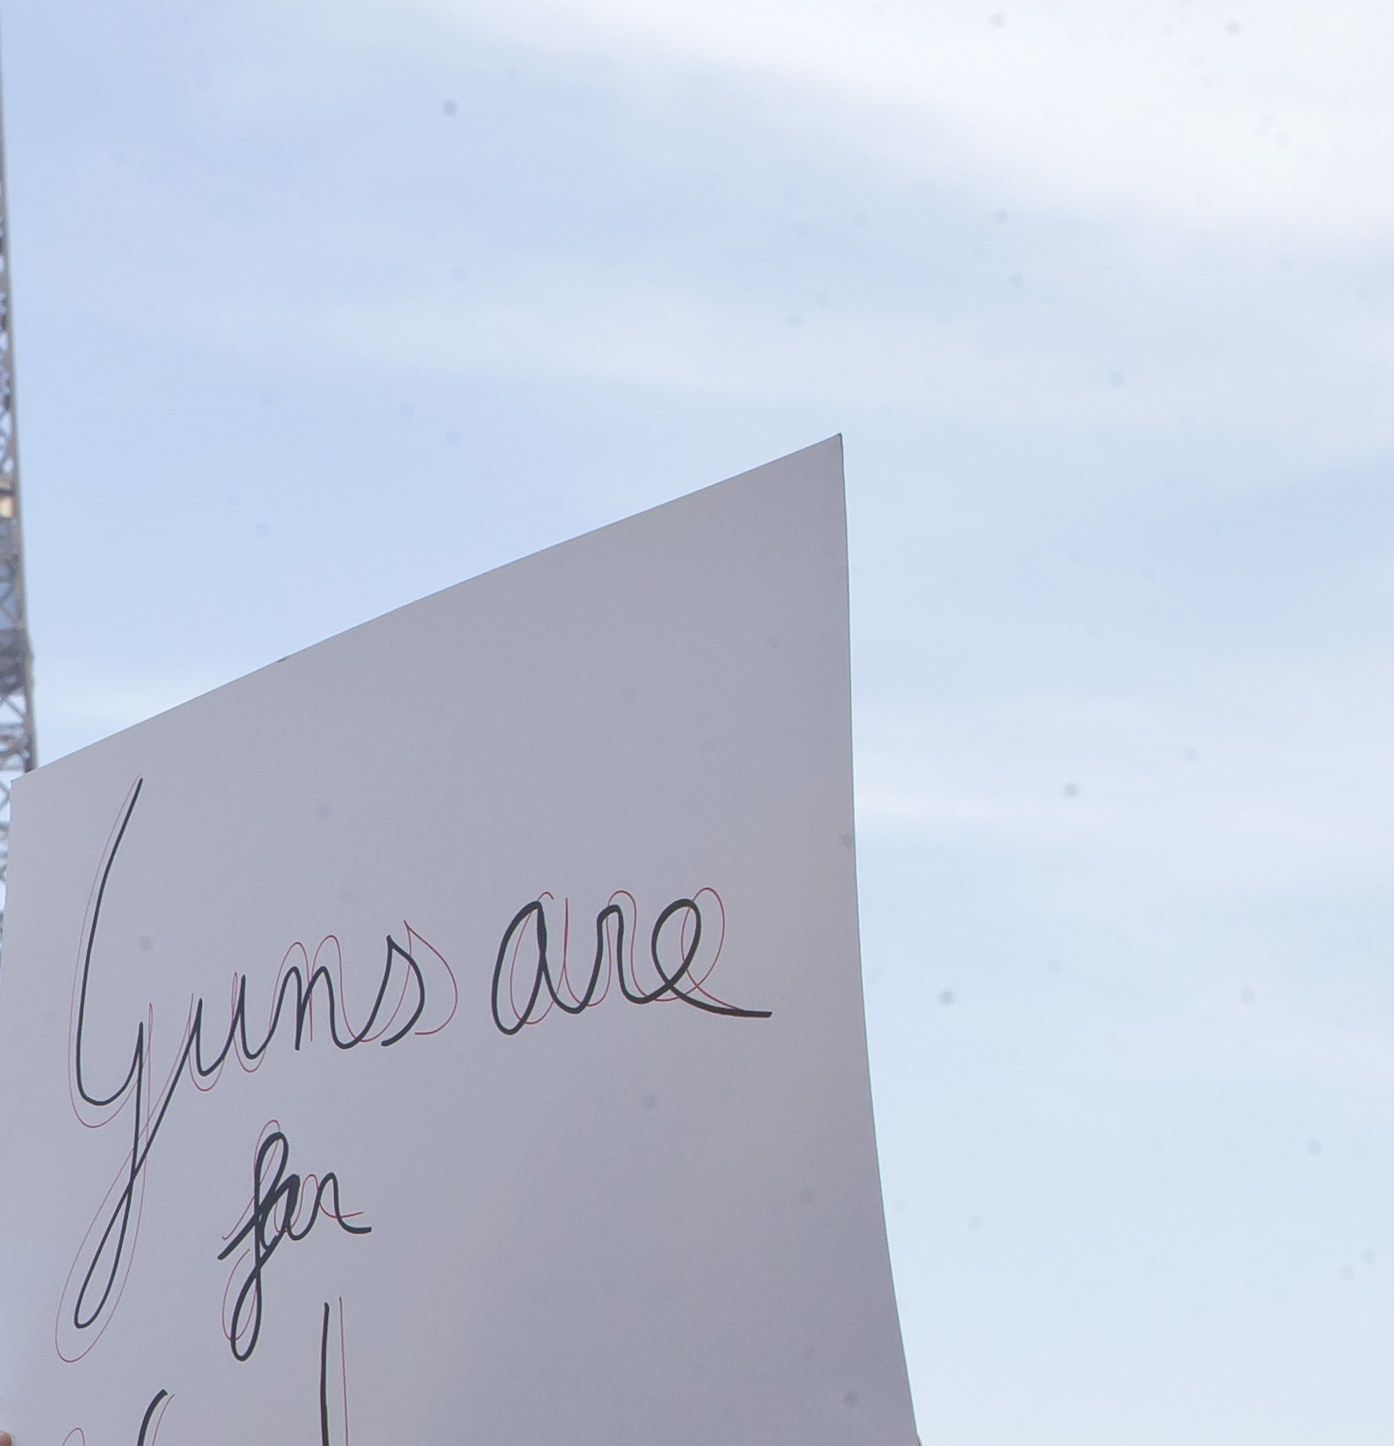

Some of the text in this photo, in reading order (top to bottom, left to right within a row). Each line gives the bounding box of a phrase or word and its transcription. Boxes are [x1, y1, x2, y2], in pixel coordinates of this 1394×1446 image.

[55, 774, 771, 1364] Guns are
[219, 1119, 372, 1361] for
